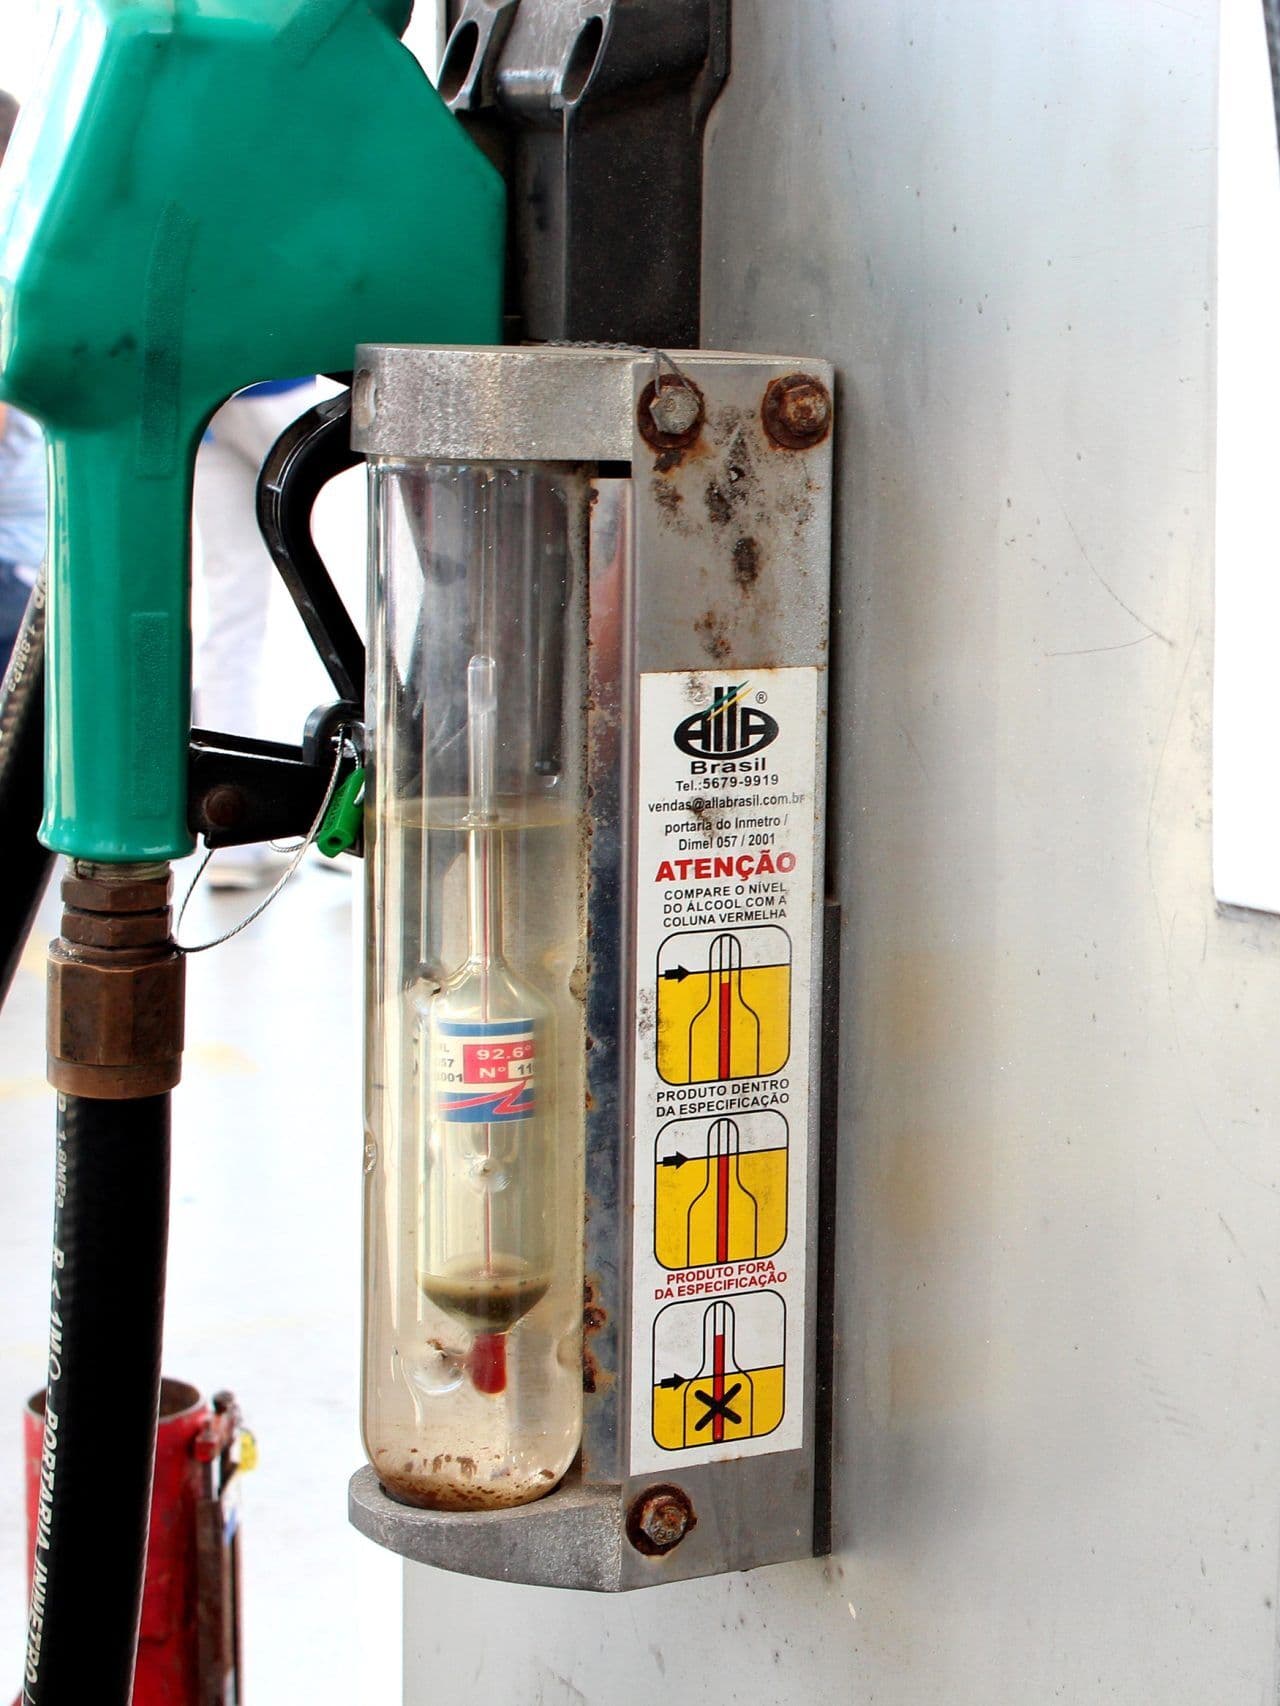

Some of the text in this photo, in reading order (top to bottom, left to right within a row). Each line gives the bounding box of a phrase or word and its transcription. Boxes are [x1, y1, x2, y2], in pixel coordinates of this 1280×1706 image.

[690, 758, 766, 774] Brasil
[665, 820, 712, 835] portaria
[717, 819, 731, 830] do
[735, 816, 780, 829] Inmetro
[679, 837, 713, 850] Dimel
[717, 836, 737, 848] 057
[749, 833, 775, 846] 2001
[655, 849, 796, 882] ATENÇÃO
[665, 881, 786, 900] COMPARE O NÍVEL
[664, 896, 787, 914] DO ÁLCOOL COM A
[664, 909, 787, 927] COLUNA VERMELHA
[657, 1079, 789, 1102] PRODUTO DENTRO
[657, 1093, 789, 1117] DA ESPECIFICAÇÃO
[667, 1261, 775, 1284] PRODUTO FORA
[655, 1272, 787, 1300] DA ESPECIFICAÇÃO
